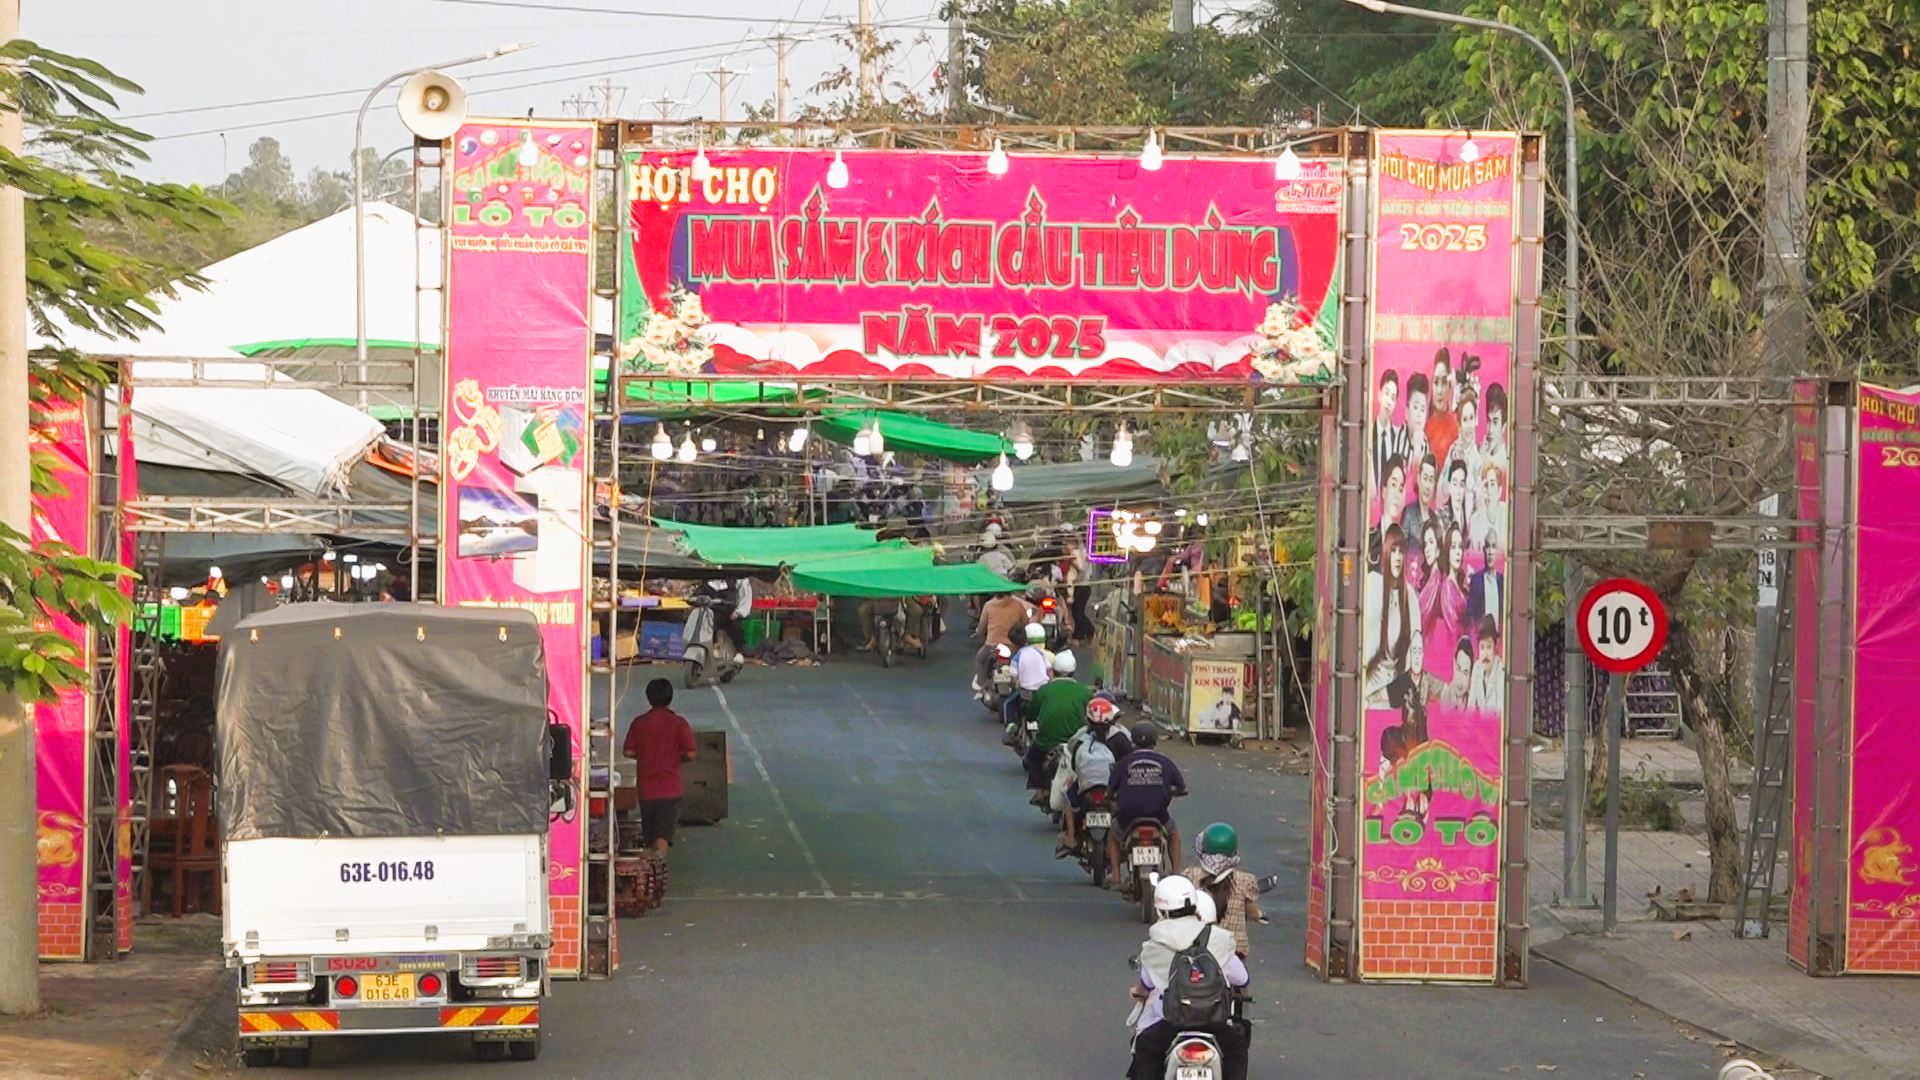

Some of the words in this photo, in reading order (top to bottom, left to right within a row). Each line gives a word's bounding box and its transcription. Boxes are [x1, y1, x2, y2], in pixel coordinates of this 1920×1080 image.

[628, 157, 691, 210] HỘI
[703, 165, 778, 212] CHỢ
[1439, 163, 1472, 193] MUA
[454, 200, 513, 226] LÔ
[522, 200, 587, 228] TÔ
[688, 215, 778, 291] MUA
[779, 183, 861, 292] SẮM
[861, 217, 892, 287] &
[892, 195, 995, 289] KÍCH
[996, 184, 1075, 294] CẦU
[1075, 203, 1169, 291] TIÊU
[1169, 201, 1281, 303] DÙNG
[1400, 221, 1489, 252] 2025
[860, 304, 985, 360] NĂM
[990, 316, 1108, 359] 2025
[1597, 606, 1631, 645] 10
[1638, 607, 1649, 626] t
[1365, 813, 1424, 845] LÔ
[1434, 812, 1498, 846] TÔ
[340, 861, 435, 883] 63E-016.48
[327, 957, 379, 971] ISUZU
[366, 987, 410, 1001] 016.48
[375, 974, 399, 987] 63E
